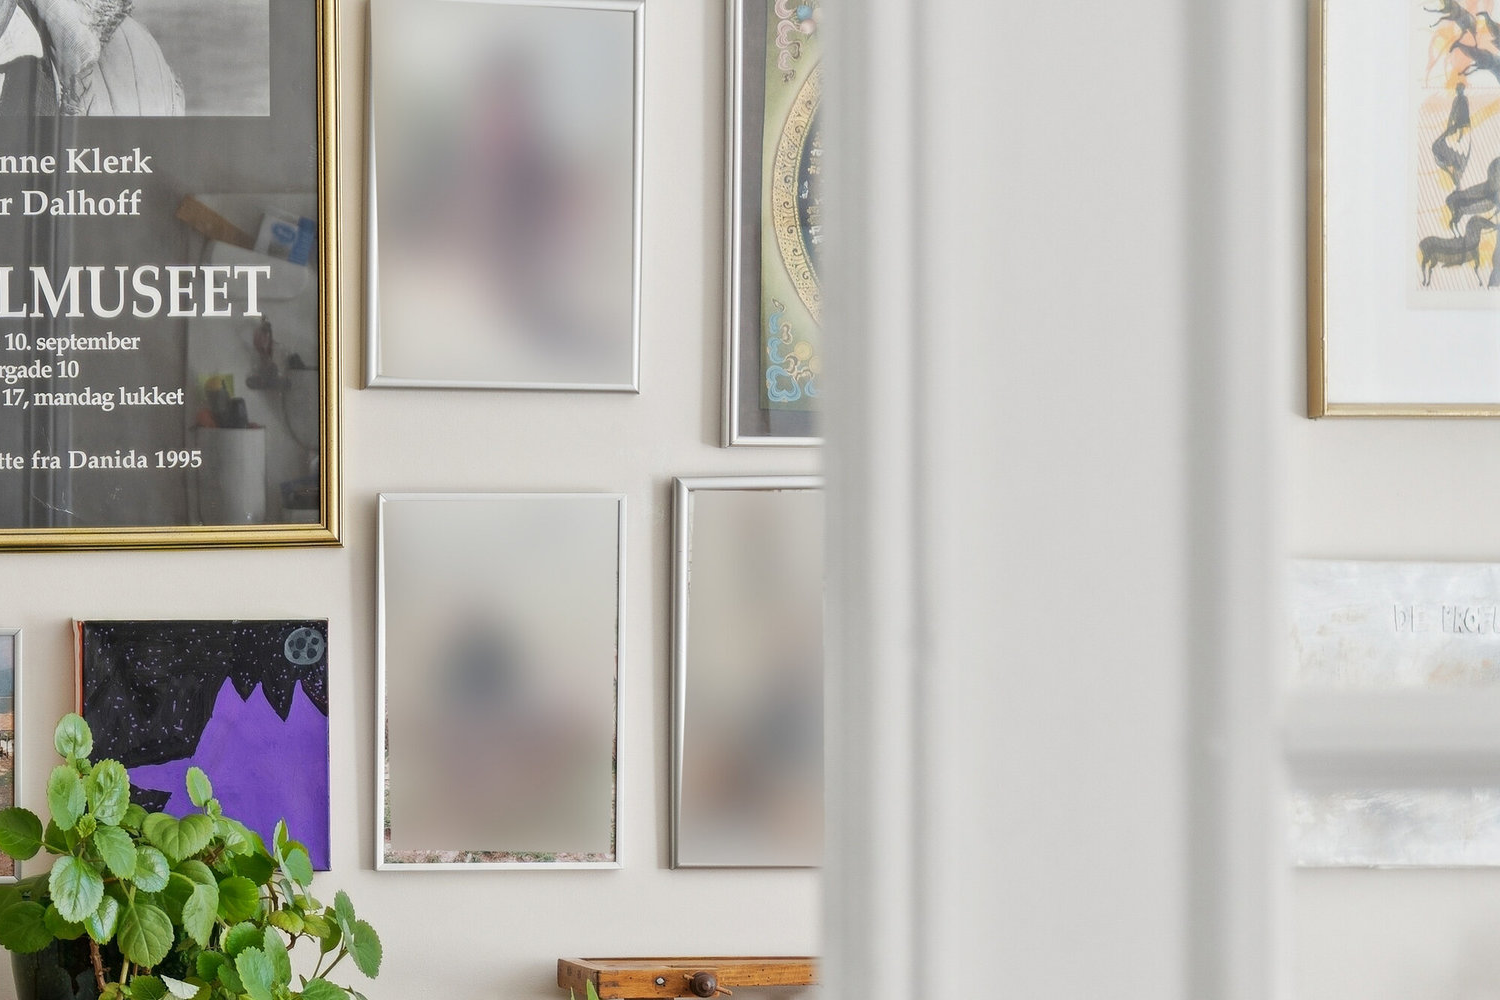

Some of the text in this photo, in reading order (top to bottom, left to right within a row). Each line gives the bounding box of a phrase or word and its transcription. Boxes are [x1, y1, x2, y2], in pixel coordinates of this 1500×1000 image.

[65, 147, 153, 174] Klerk
[21, 188, 142, 217] Dalhoff
[4, 332, 32, 351] 10.
[36, 331, 141, 357] september
[56, 359, 80, 379] 10
[1, 388, 30, 410] 17,
[33, 386, 116, 412] mandag
[118, 385, 185, 406] lukket
[30, 447, 62, 470] fra
[67, 449, 149, 469] Danida
[154, 450, 203, 469] 1995
